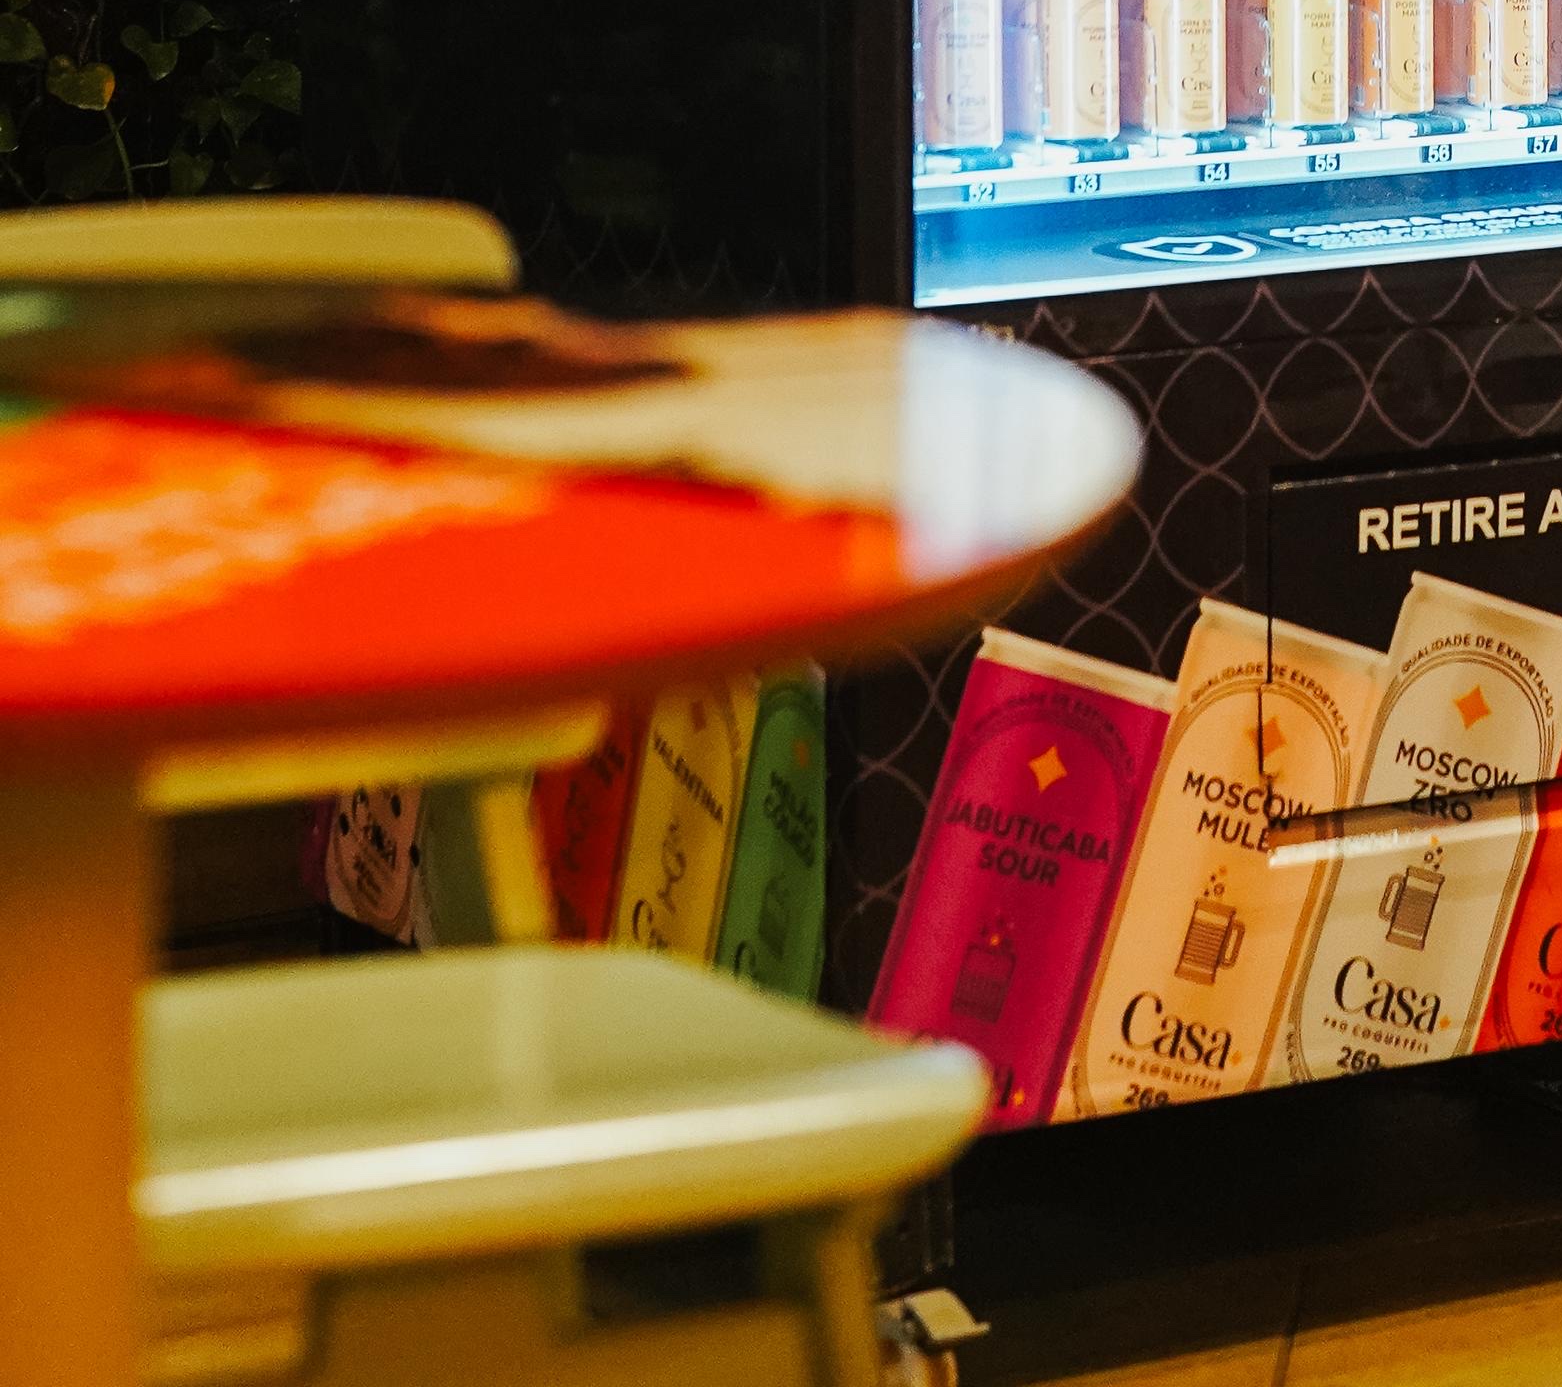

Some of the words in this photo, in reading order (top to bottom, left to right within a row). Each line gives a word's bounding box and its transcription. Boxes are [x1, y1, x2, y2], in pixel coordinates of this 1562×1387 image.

[1314, 154, 1338, 171] 55
[1534, 136, 1556, 153] 57
[1204, 164, 1228, 181] 54
[1358, 491, 1526, 553] RETIRE
[1400, 633, 1472, 674] QUALIDADE
[1475, 635, 1495, 650] DE
[1395, 738, 1520, 794] MOSCOW
[1182, 770, 1314, 827] MOSCOW
[1410, 778, 1473, 823] ZERO
[944, 797, 1110, 863] JABUTICABA
[1197, 810, 1271, 854] MULE
[979, 841, 1061, 886] SOUR
[1335, 955, 1441, 1035] Casa
[1121, 990, 1232, 1071] Casa
